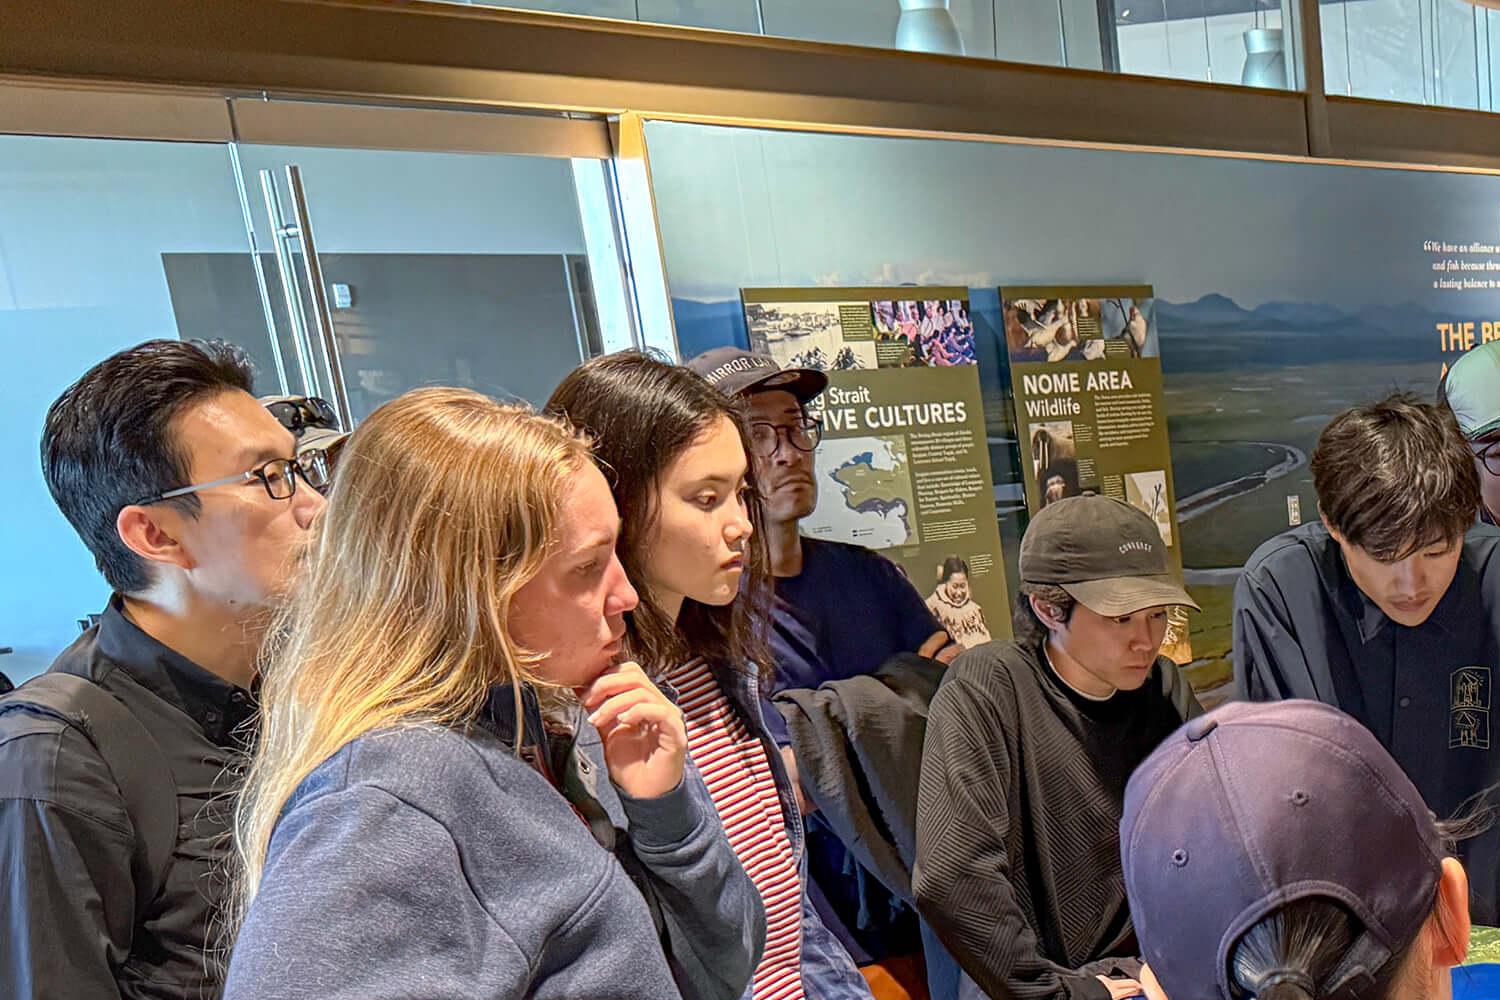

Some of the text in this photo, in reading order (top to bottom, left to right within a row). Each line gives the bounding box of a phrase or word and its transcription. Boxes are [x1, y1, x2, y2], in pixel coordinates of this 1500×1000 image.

[1436, 322, 1475, 352] THE
[704, 357, 751, 386] MIRROR
[1023, 370, 1133, 395] NOME AREA
[829, 385, 871, 405] Strait
[1025, 397, 1080, 418] Wildlife
[865, 401, 967, 428] CULTURES
